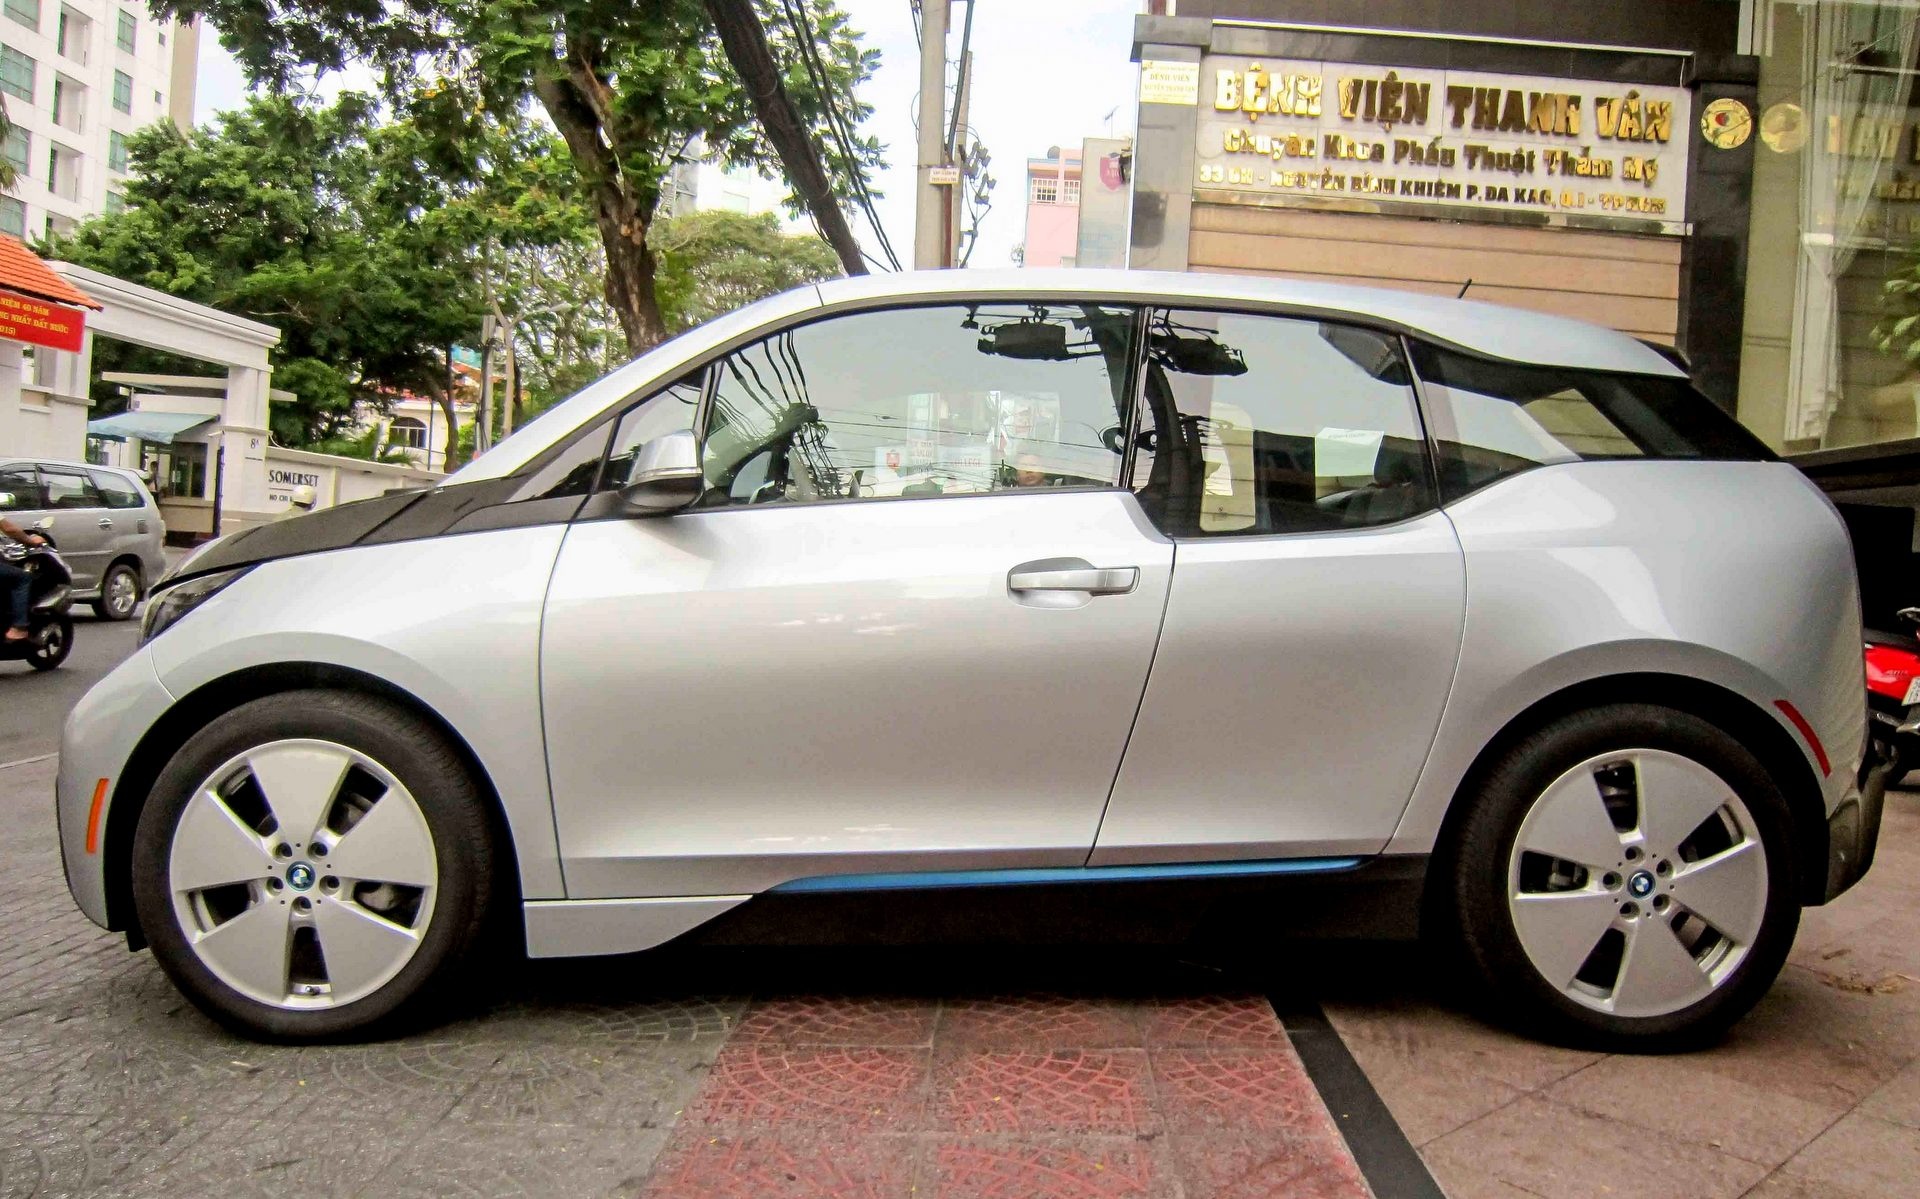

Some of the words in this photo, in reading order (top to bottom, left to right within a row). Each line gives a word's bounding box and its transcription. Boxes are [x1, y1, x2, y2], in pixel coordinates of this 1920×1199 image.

[1214, 62, 1322, 122] BỆNH
[1338, 71, 1431, 132] VIỆN
[1447, 85, 1582, 136] THANH
[1595, 89, 1673, 144] VÂN
[1223, 128, 1316, 161] Chuyên
[1323, 134, 1385, 163] Khoa
[1463, 144, 1536, 178] Thuật
[1199, 164, 1223, 183] 33
[1400, 179, 1461, 199] KHIÊM
[22, 303, 32, 312] 40
[268, 469, 319, 487] SOMERSET
